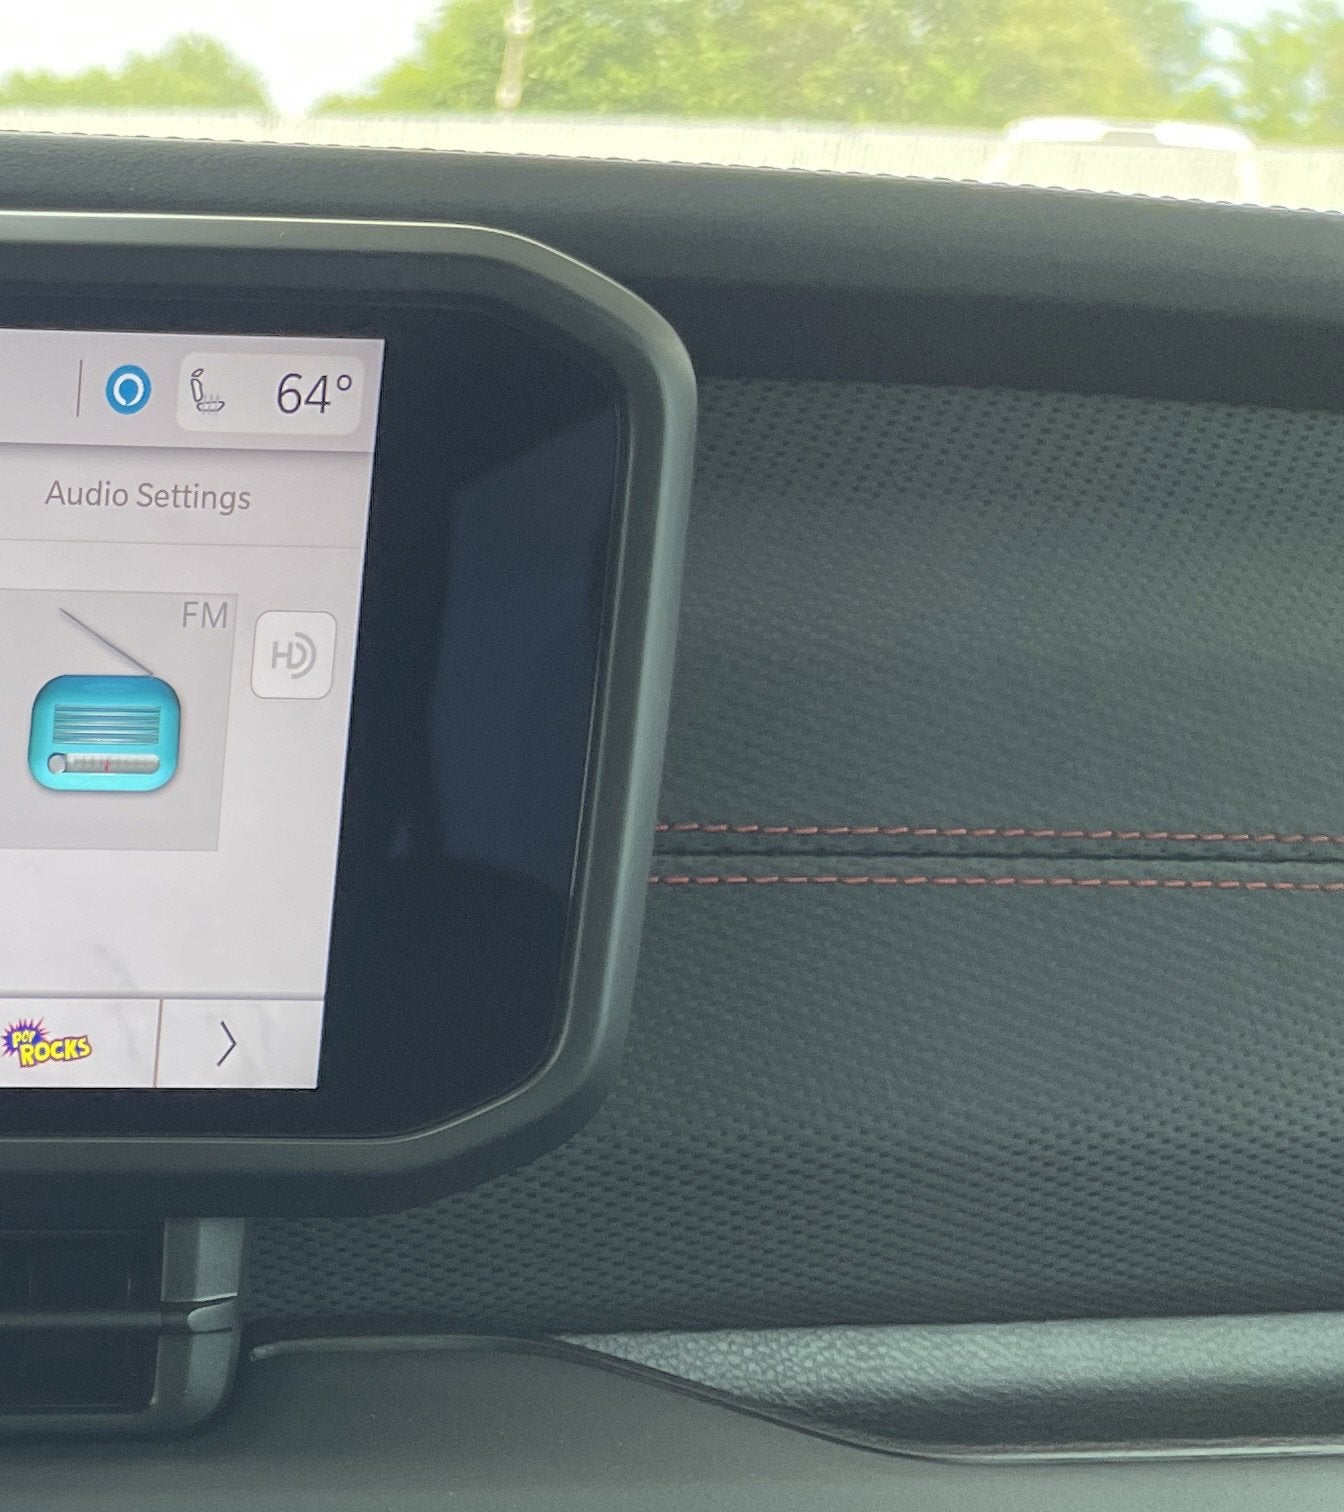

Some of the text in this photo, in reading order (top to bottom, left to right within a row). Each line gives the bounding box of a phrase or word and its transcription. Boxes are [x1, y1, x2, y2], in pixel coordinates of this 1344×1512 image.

[276, 371, 353, 415] 64°
[45, 480, 251, 514] Audio Settings
[182, 601, 228, 629] FM
[19, 1036, 91, 1067] ROCKS
